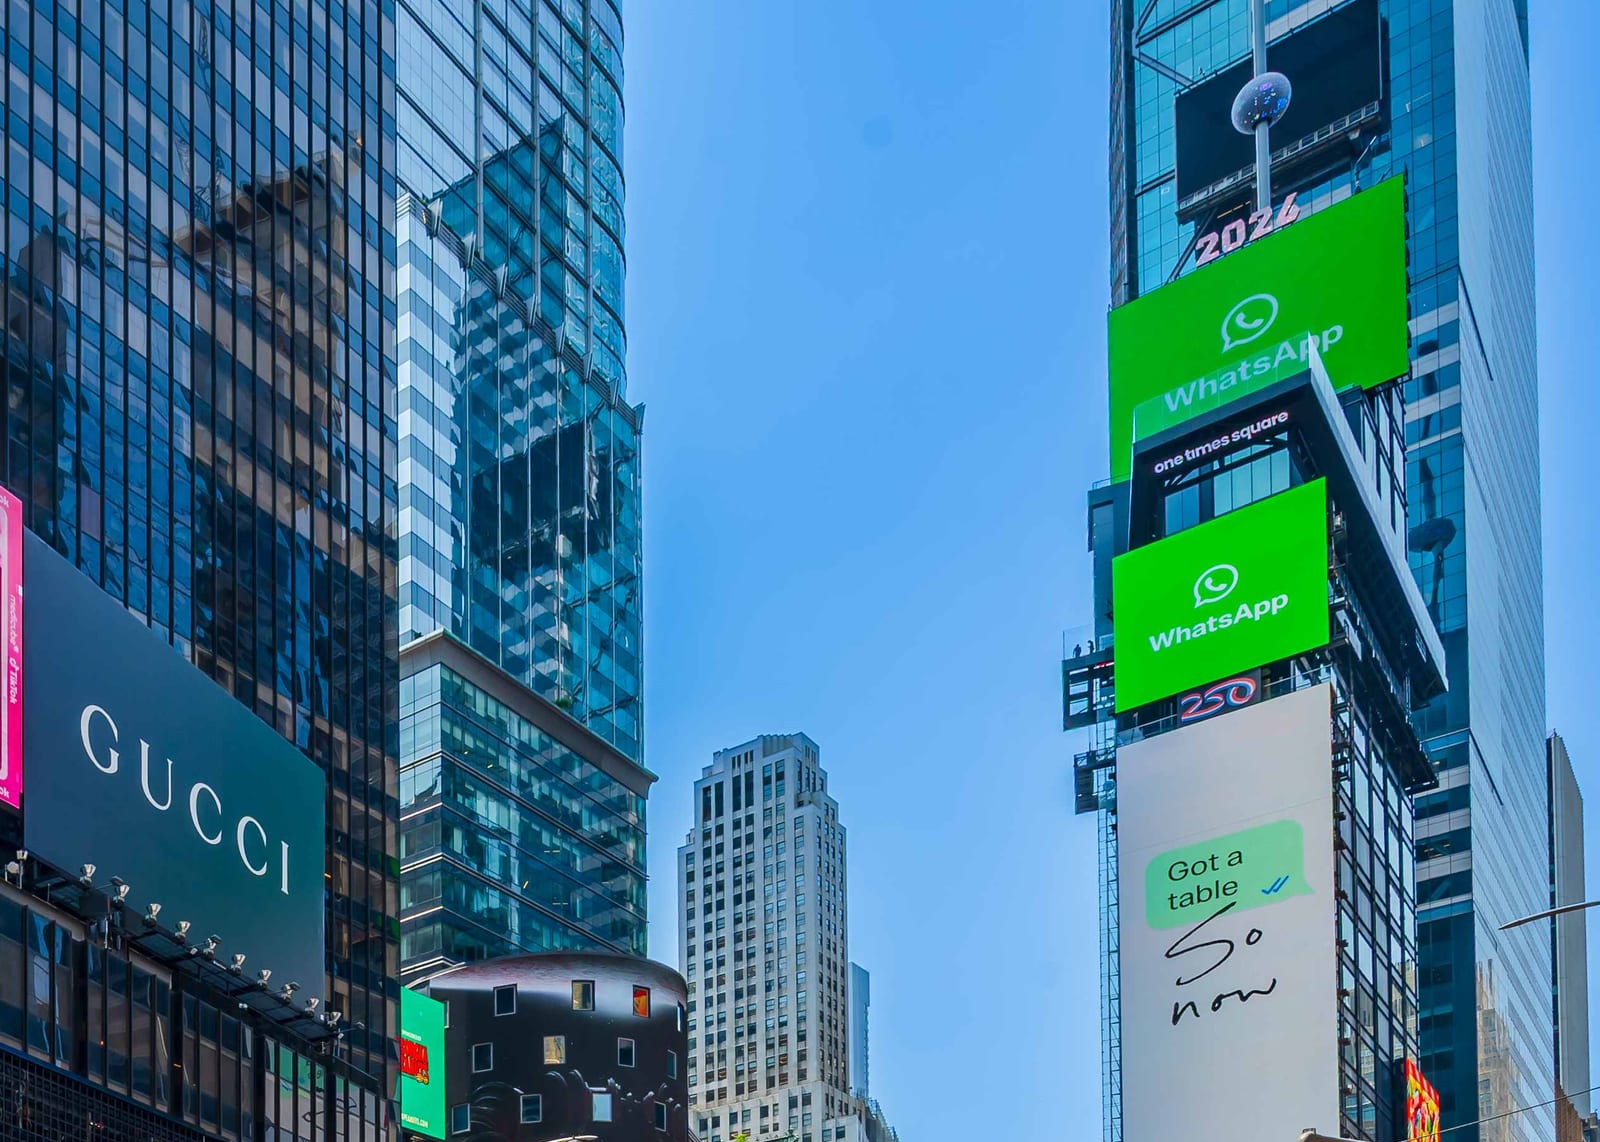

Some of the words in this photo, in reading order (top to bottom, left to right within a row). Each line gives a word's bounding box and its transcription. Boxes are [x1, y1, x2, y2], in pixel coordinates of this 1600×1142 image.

[1195, 191, 1301, 267] 2026
[1164, 322, 1344, 414] WhatsApp
[1154, 451, 1183, 475] one
[1184, 434, 1230, 463] times
[1231, 410, 1289, 444] square
[1148, 591, 1289, 654] WhatsApp
[1180, 674, 1257, 724] 250
[80, 704, 290, 895] GUCCI
[1167, 859, 1221, 882] Got
[1227, 852, 1243, 868] a
[1168, 878, 1239, 910] table
[1165, 902, 1263, 985] So
[1172, 977, 1277, 1025] now
